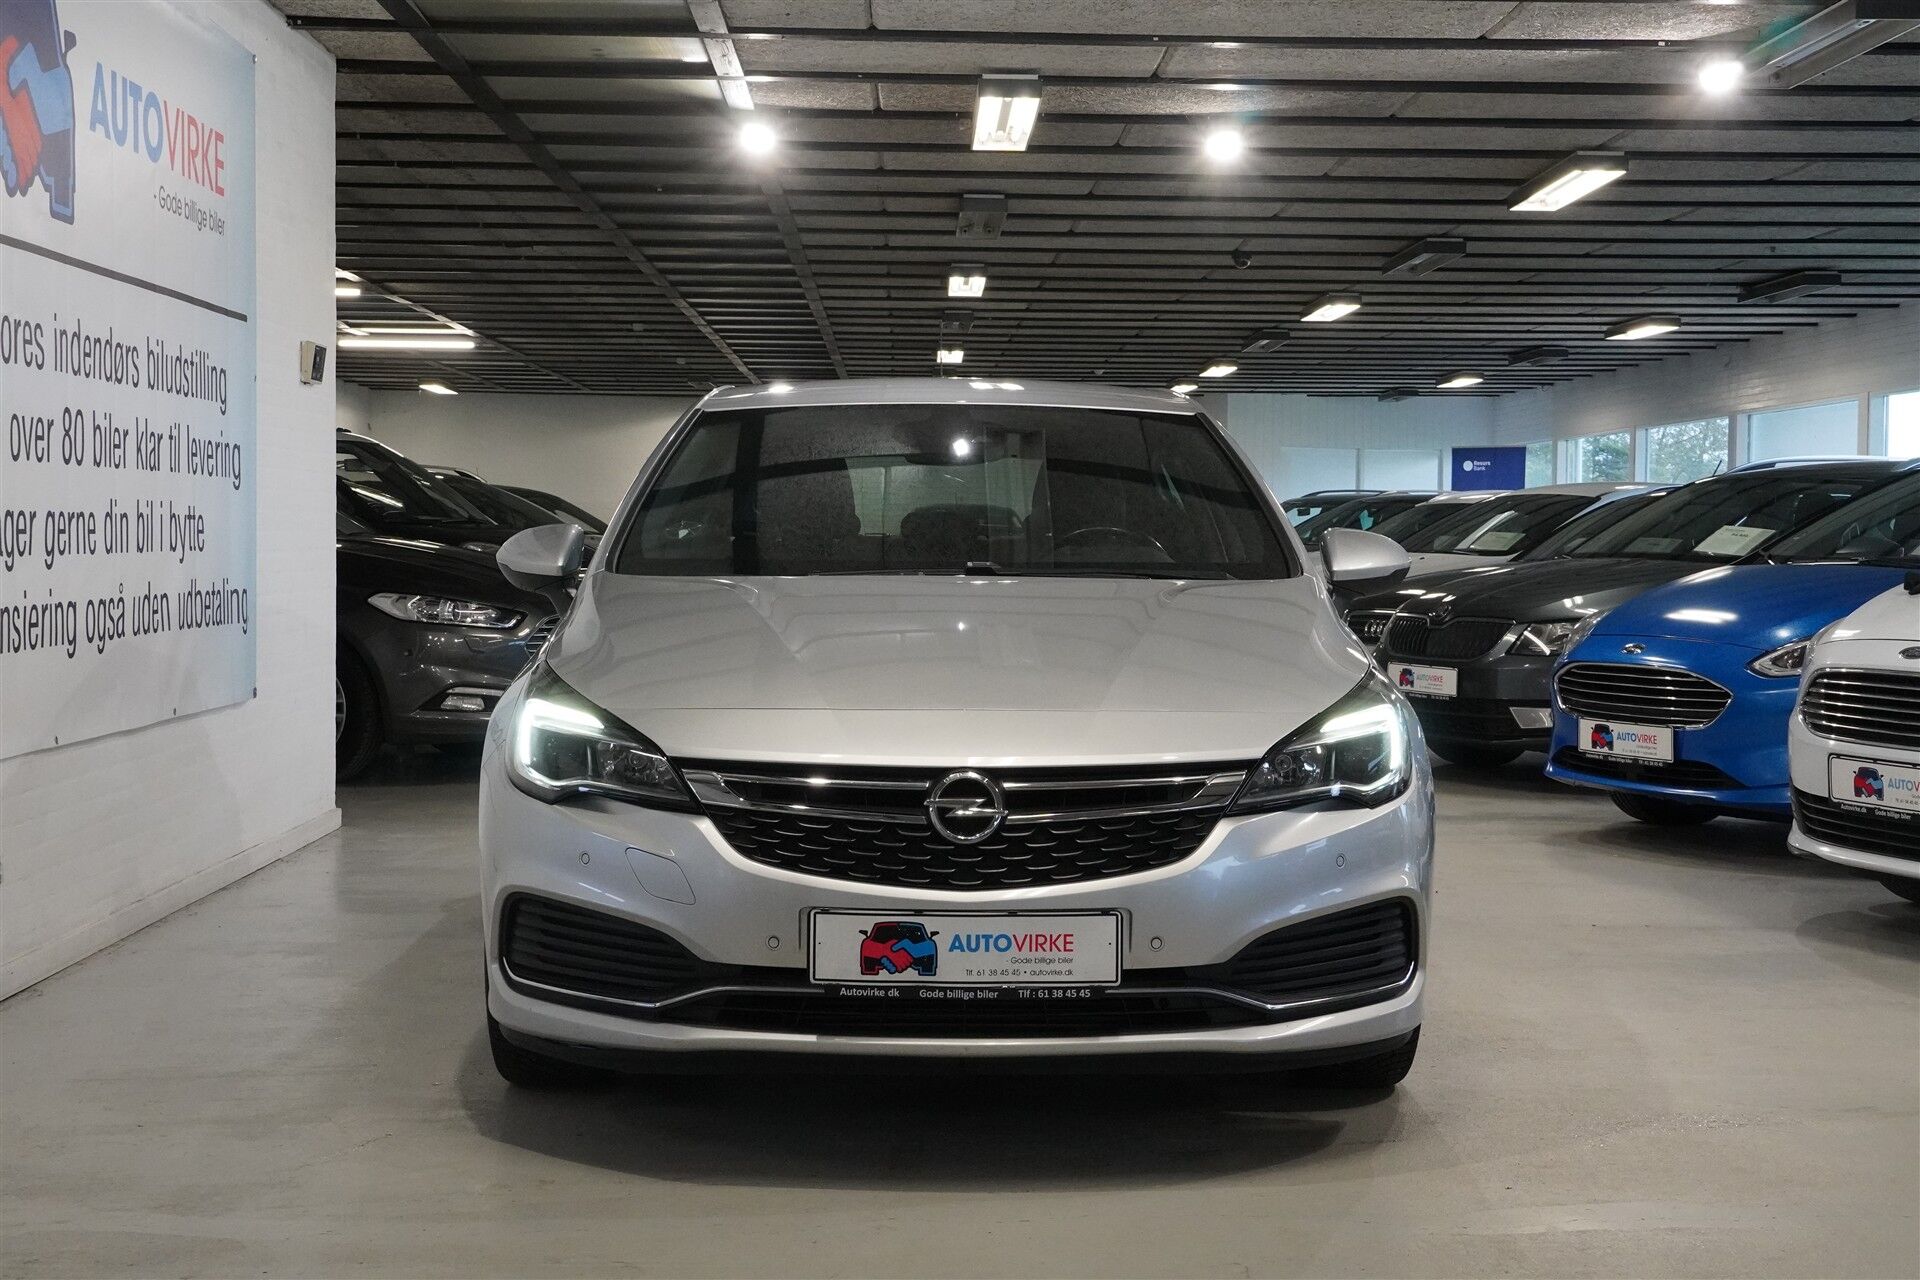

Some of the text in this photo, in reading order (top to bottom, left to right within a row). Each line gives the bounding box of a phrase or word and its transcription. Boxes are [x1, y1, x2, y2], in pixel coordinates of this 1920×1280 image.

[89, 61, 225, 197] AUTOVIRKE
[158, 185, 183, 215] Gode
[184, 199, 207, 232] billige
[208, 207, 225, 236] biler
[54, 313, 140, 388] indendørs
[147, 336, 227, 415] biludstilling
[10, 406, 241, 490] over 80 biler klar til levering
[0, 498, 205, 572] ger gerne din bil i bytte
[85, 582, 125, 655] også
[132, 581, 171, 637] uden
[178, 578, 248, 635] udbetaling
[1616, 731, 1657, 744] AUTOVIRKE
[948, 933, 1074, 953] AUTOVIRKE
[1010, 956, 1033, 964] Gode
[1034, 956, 1056, 965] billige
[1057, 956, 1074, 964] biler
[919, 989, 944, 998] Gode
[946, 989, 975, 1000] billige
[977, 989, 999, 998] biler
[1038, 989, 1049, 998] 61
[1051, 989, 1063, 998] 38
[1065, 989, 1077, 998] 45
[1079, 989, 1091, 998] 45
